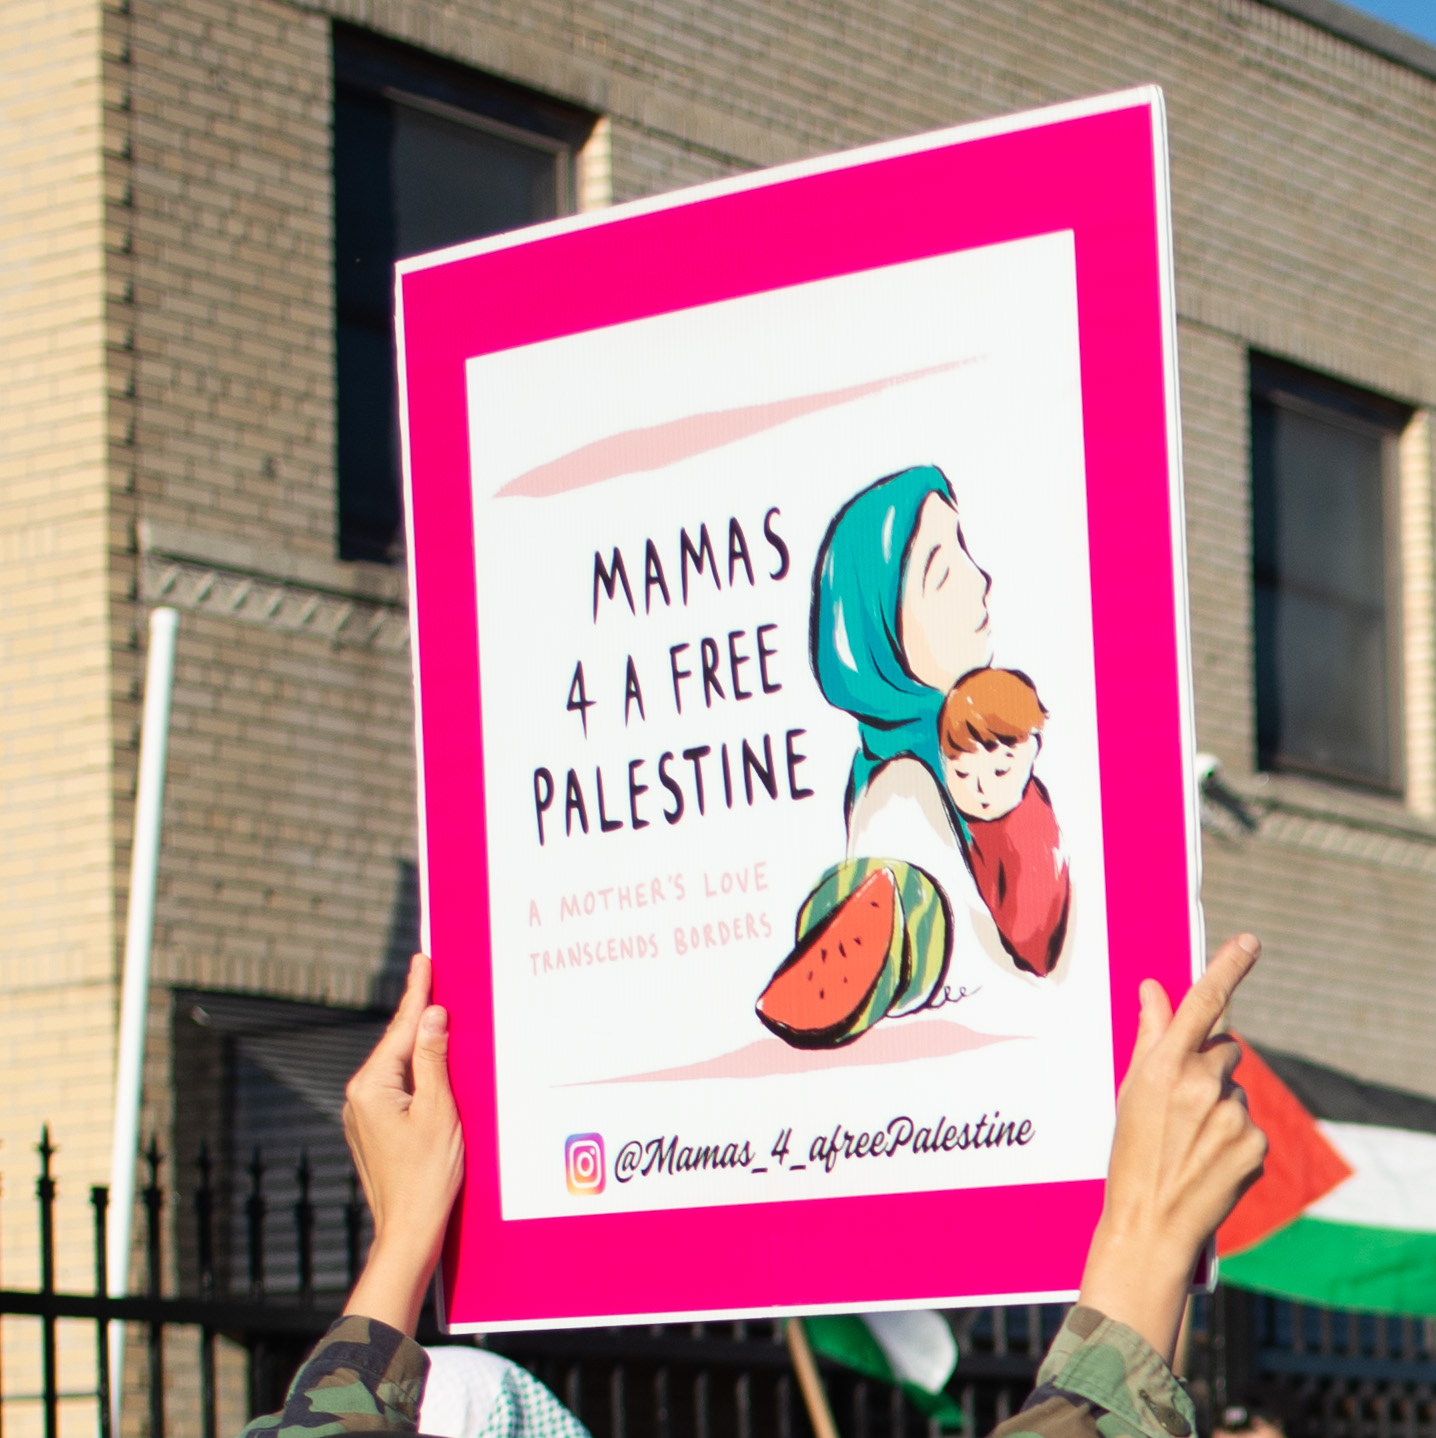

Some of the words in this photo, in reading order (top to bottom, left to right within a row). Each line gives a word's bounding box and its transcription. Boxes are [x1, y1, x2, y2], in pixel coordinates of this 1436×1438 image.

[593, 507, 791, 624] MAMAS
[566, 660, 597, 739] 4
[624, 655, 646, 726] A
[669, 622, 783, 716] FREE
[532, 728, 816, 847] PALESTINE
[529, 900, 542, 926] A
[560, 873, 686, 921] MOTHER'S
[704, 862, 768, 898] LOVE
[529, 934, 659, 975] TRANSCENDS
[674, 912, 773, 956] BORDERS
[614, 1110, 1034, 1185] @Mamas_4_afreePalestine
